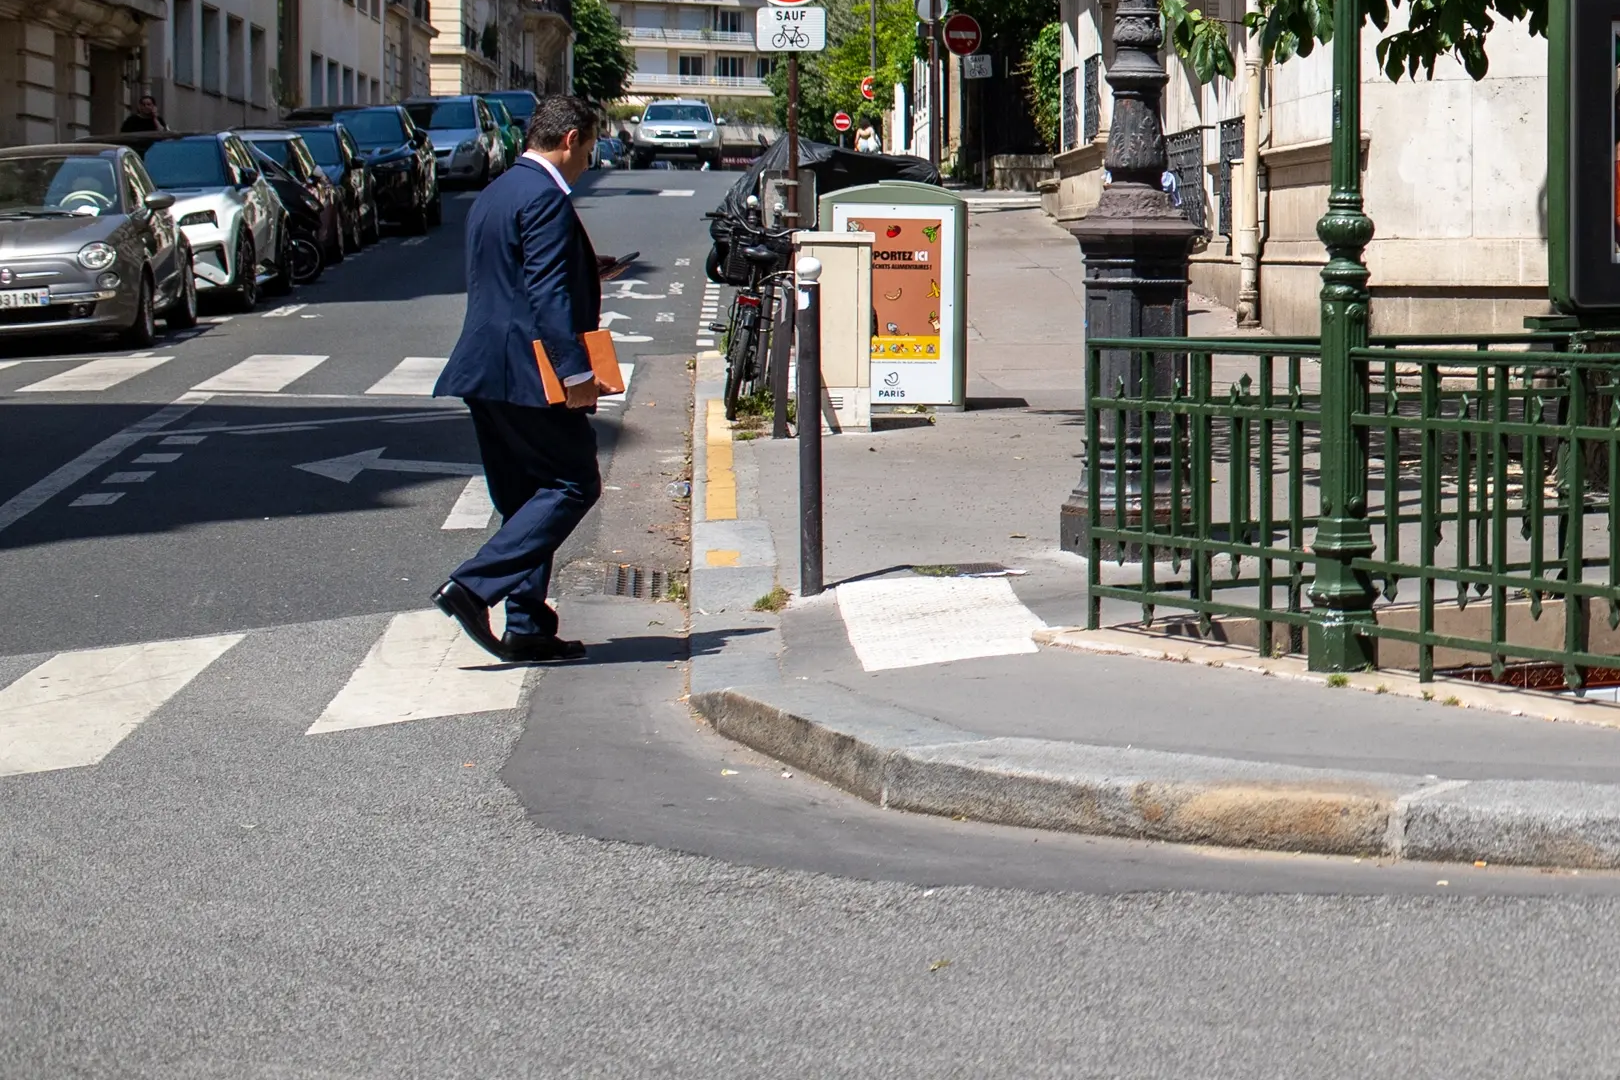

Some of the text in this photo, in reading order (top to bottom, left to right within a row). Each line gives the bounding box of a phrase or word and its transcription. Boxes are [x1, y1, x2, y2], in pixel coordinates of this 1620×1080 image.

[776, 10, 807, 21] SAUF
[871, 250, 928, 261] PORTEZ ICI
[878, 390, 906, 398] PARIS
